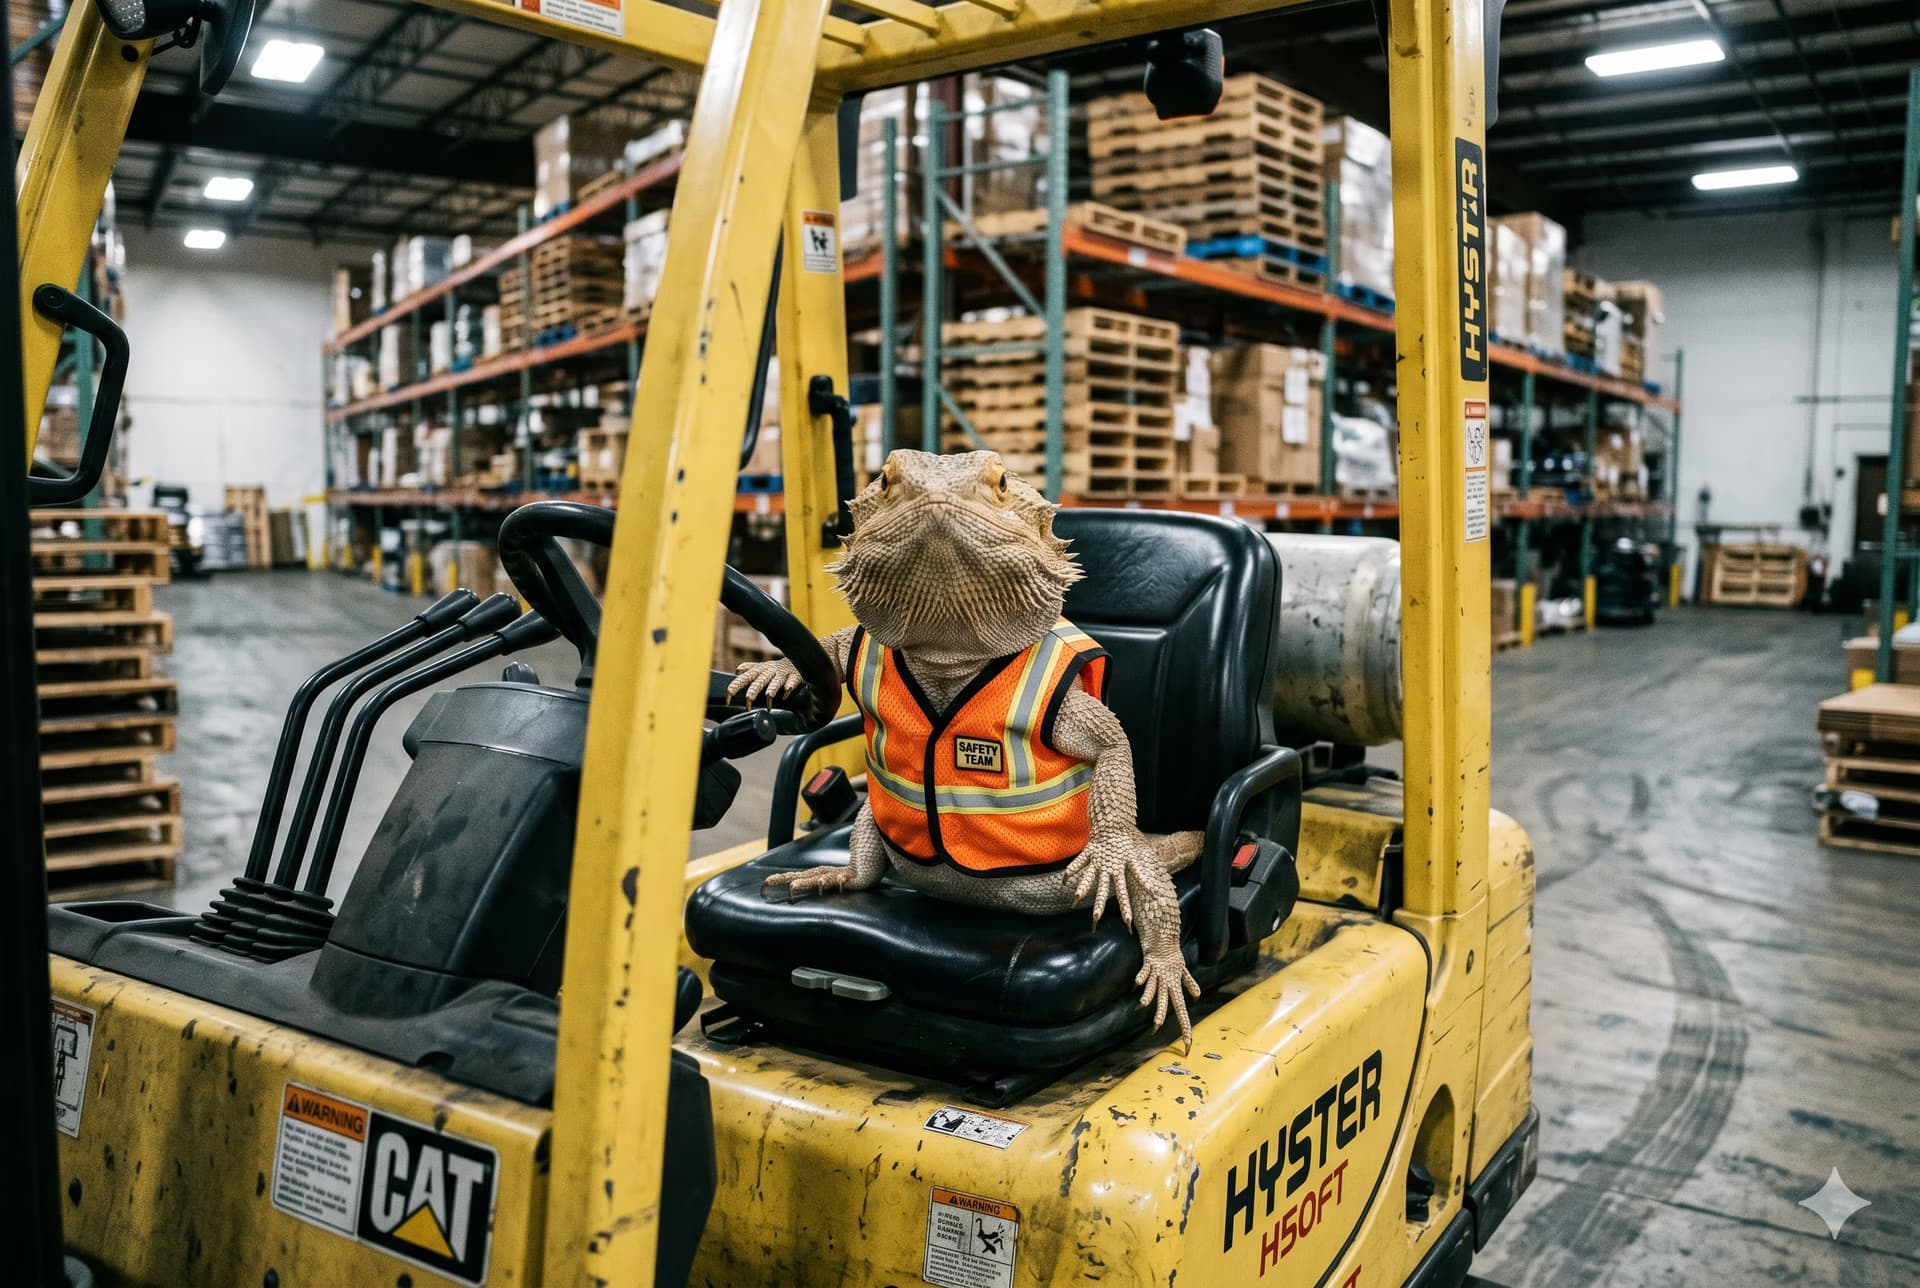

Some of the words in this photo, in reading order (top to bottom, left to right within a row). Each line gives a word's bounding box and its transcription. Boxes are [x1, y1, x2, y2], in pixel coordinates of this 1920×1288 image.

[959, 741, 998, 757] SAFETY
[964, 753, 993, 767] TEAM
[302, 1098, 363, 1134] WARNING
[1223, 1049, 1383, 1254] HYSTER
[370, 1131, 485, 1264] CAT
[958, 1196, 1001, 1215] WARNING
